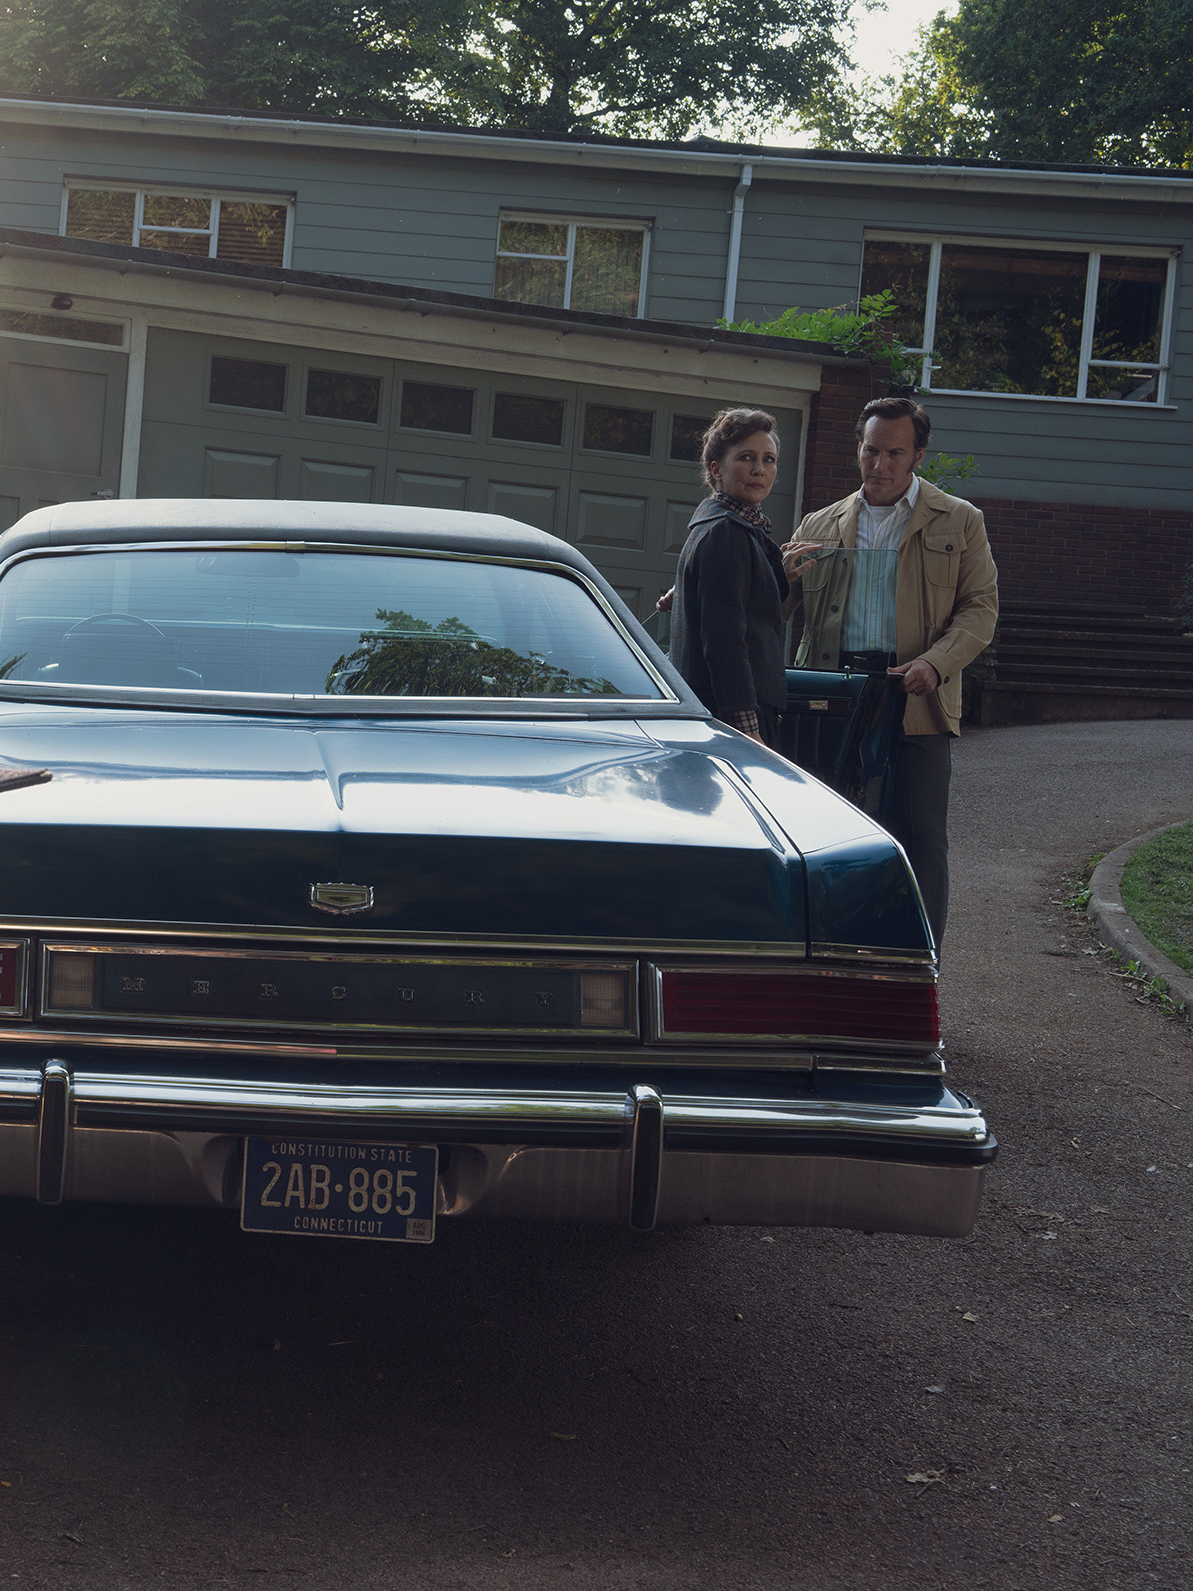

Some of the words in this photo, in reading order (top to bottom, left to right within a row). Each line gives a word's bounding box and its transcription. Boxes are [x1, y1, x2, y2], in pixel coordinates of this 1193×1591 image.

[120, 976, 553, 1006] MERCURY
[272, 1142, 367, 1160] CONSTITUTION
[370, 1149, 412, 1163] STATE
[294, 1216, 383, 1234] CONNECTICUT
